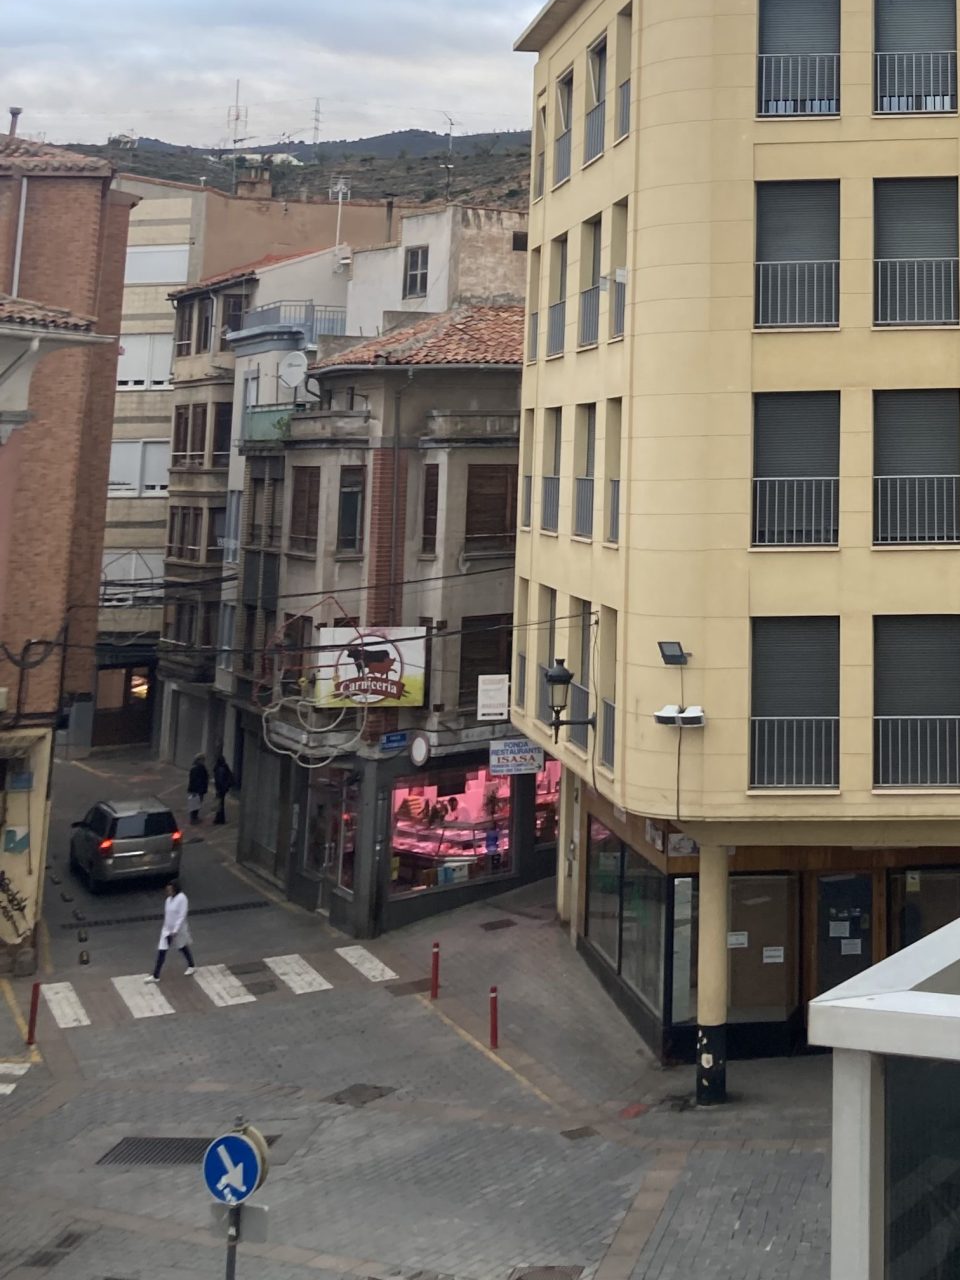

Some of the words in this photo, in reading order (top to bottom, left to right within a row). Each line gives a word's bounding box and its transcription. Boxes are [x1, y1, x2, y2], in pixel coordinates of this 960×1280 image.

[340, 678, 397, 694] Carnicería
[491, 748, 542, 756] RESTAURANTE
[498, 755, 536, 763] ISASA
